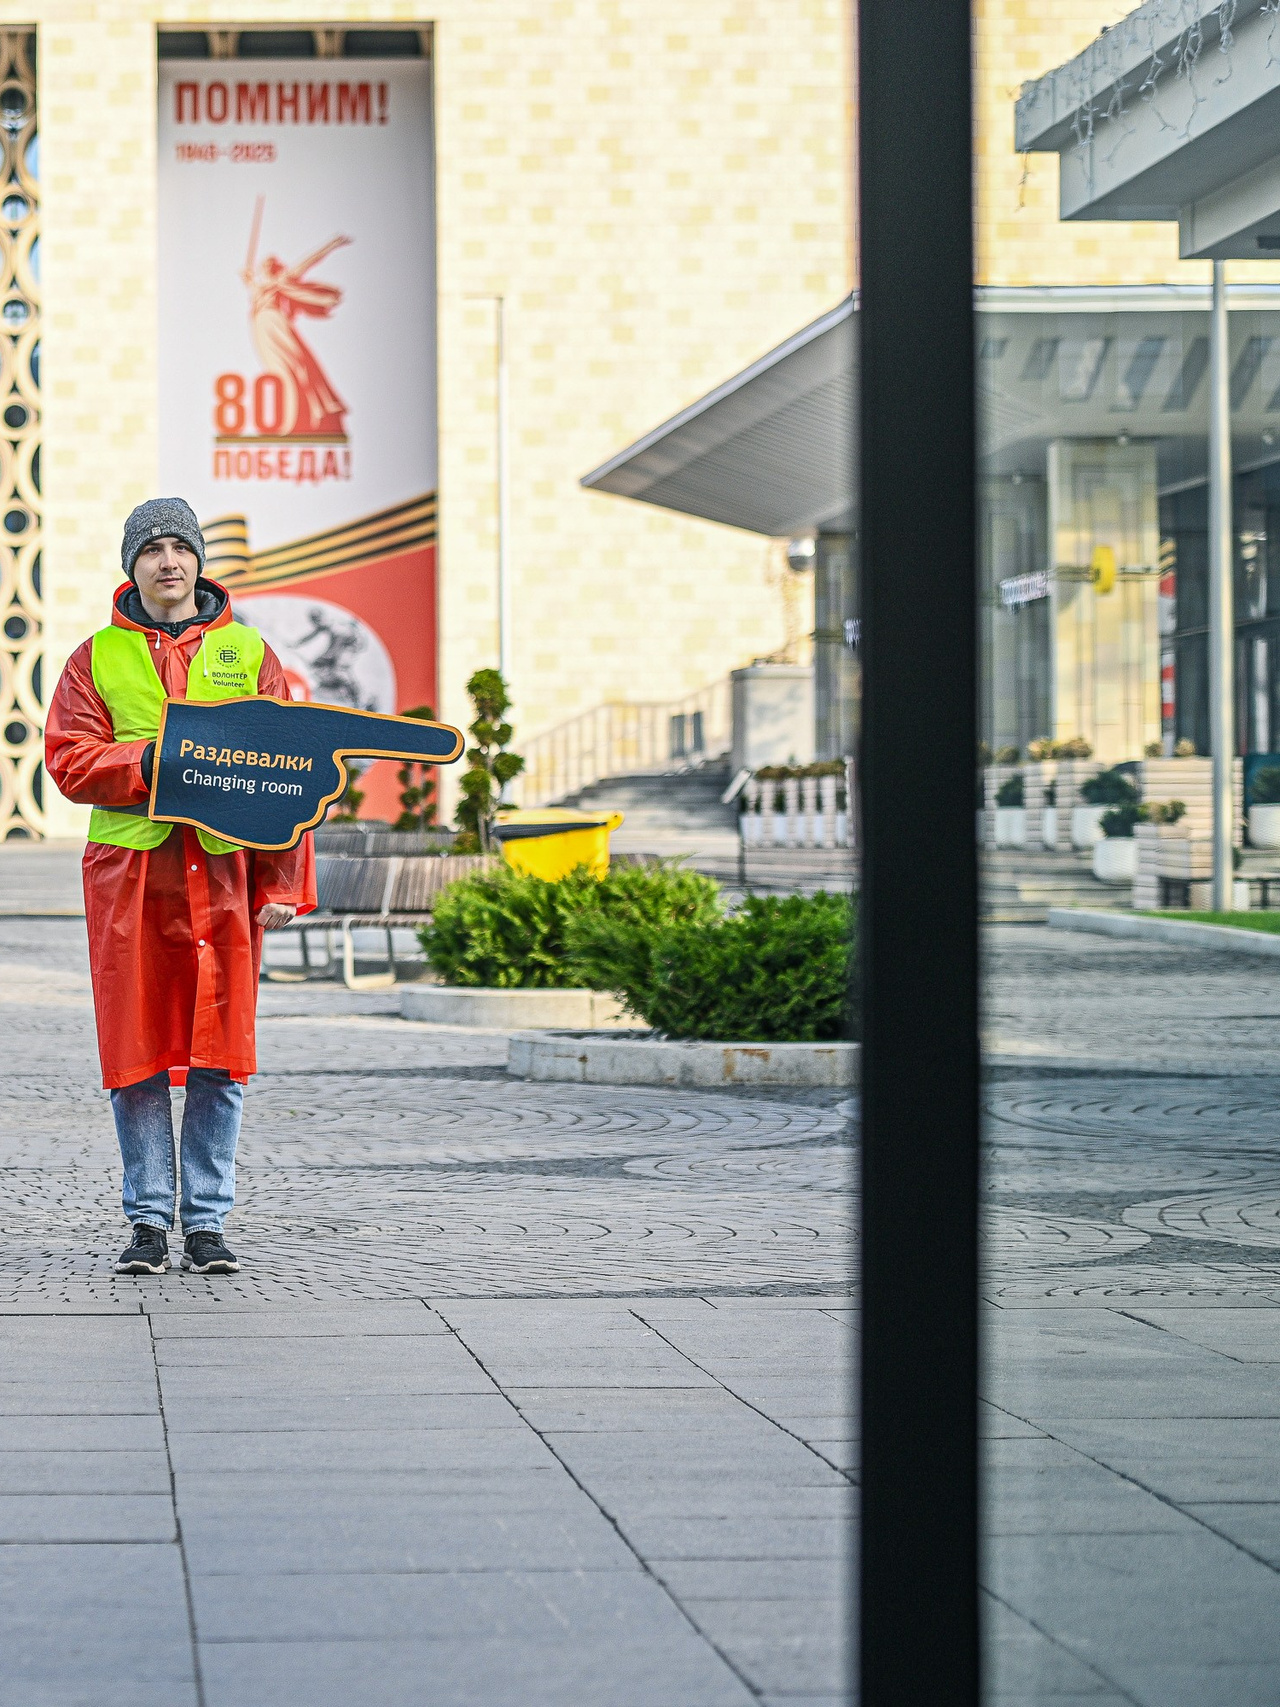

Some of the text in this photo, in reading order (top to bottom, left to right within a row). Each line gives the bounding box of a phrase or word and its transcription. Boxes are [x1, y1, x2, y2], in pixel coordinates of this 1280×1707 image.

[175, 81, 389, 125] ПОМНИМ!
[214, 373, 285, 435] 80
[214, 449, 351, 484] ПОБЕДА!
[213, 679, 245, 688] Volunteer
[179, 738, 313, 772] Раздевалки
[182, 769, 303, 796] Changing room
